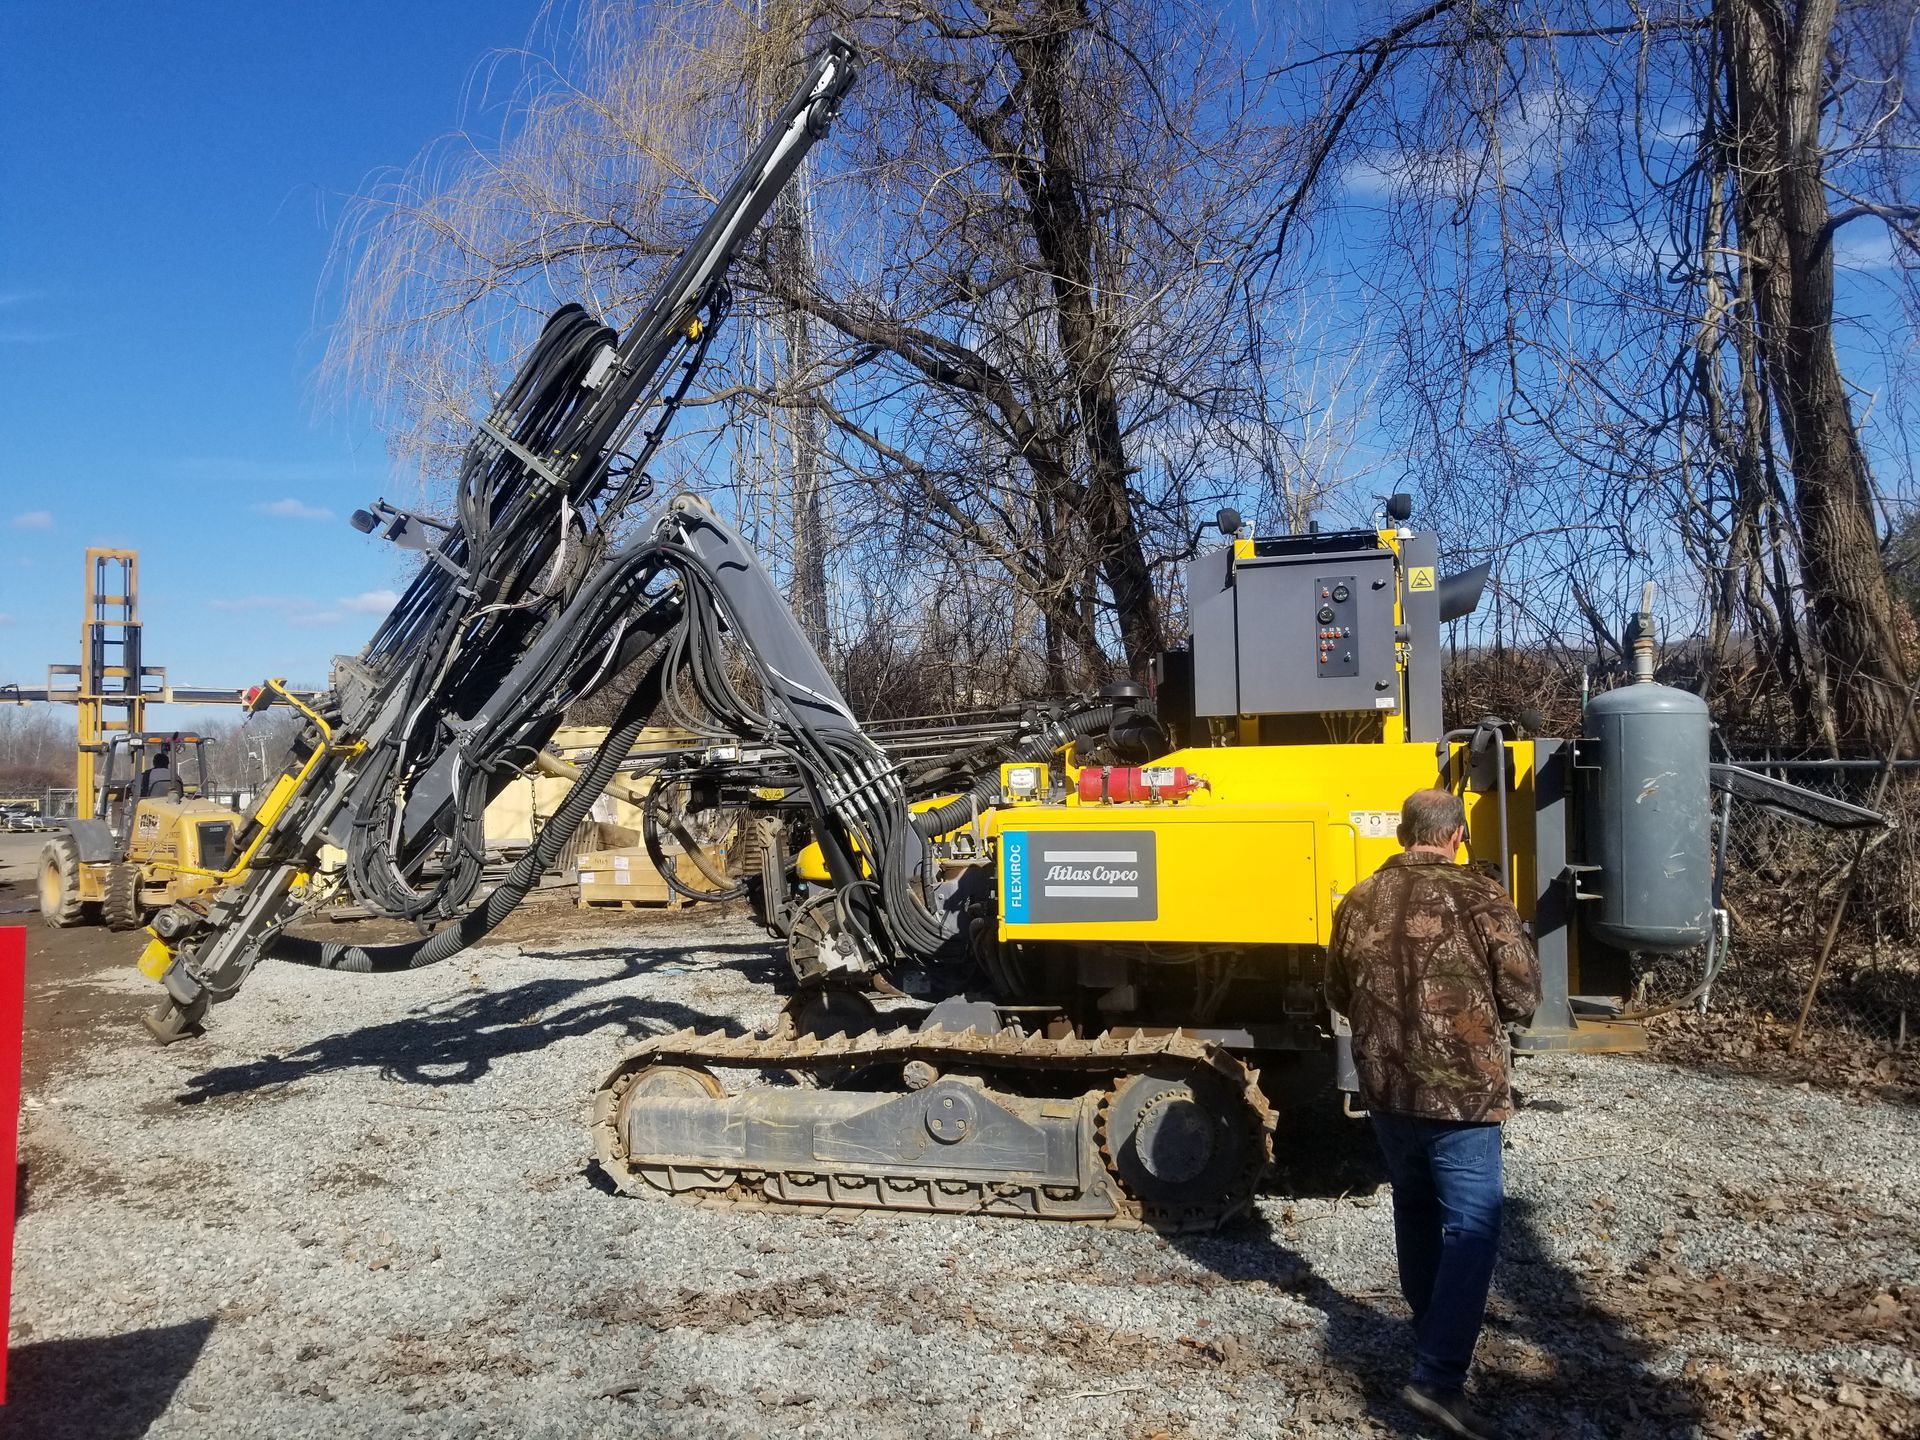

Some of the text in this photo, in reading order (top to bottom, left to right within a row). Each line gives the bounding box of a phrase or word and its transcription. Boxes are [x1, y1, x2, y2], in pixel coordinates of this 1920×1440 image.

[1010, 844, 1022, 908] FLEXIROC
[1044, 865, 1138, 884] Atlas Copco
